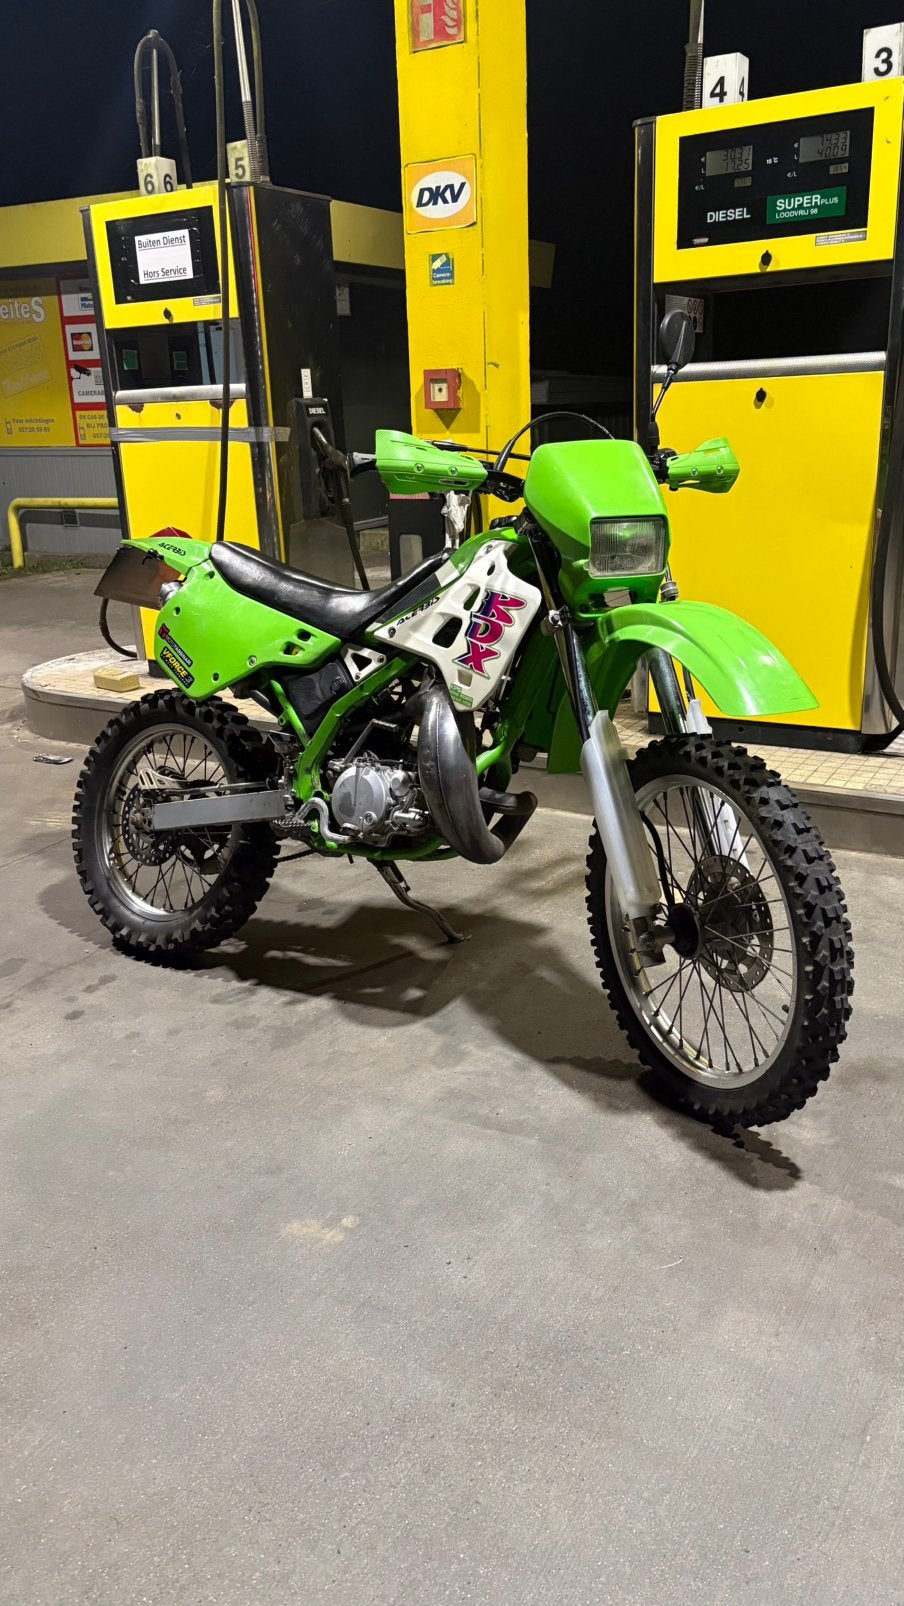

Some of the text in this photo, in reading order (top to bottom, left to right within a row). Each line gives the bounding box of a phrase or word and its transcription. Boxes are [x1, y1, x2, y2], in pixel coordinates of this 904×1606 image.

[873, 46, 893, 77] 3
[709, 75, 728, 104] 4
[738, 76, 746, 102] 4
[234, 156, 246, 180] 5
[143, 173, 155, 195] 6
[163, 173, 174, 193] 6
[416, 181, 467, 208] DKV
[775, 208, 818, 219] LOODVRIJ 98
[776, 194, 821, 211] SUPER
[706, 207, 751, 223] DIESEL
[137, 234, 186, 249] Buiten Dienst
[143, 265, 187, 279] Hors Service
[158, 541, 186, 557] ACERBIS
[396, 596, 441, 627] ACERBIS
[452, 588, 527, 680] KDX
[162, 647, 189, 678] VFORCE
